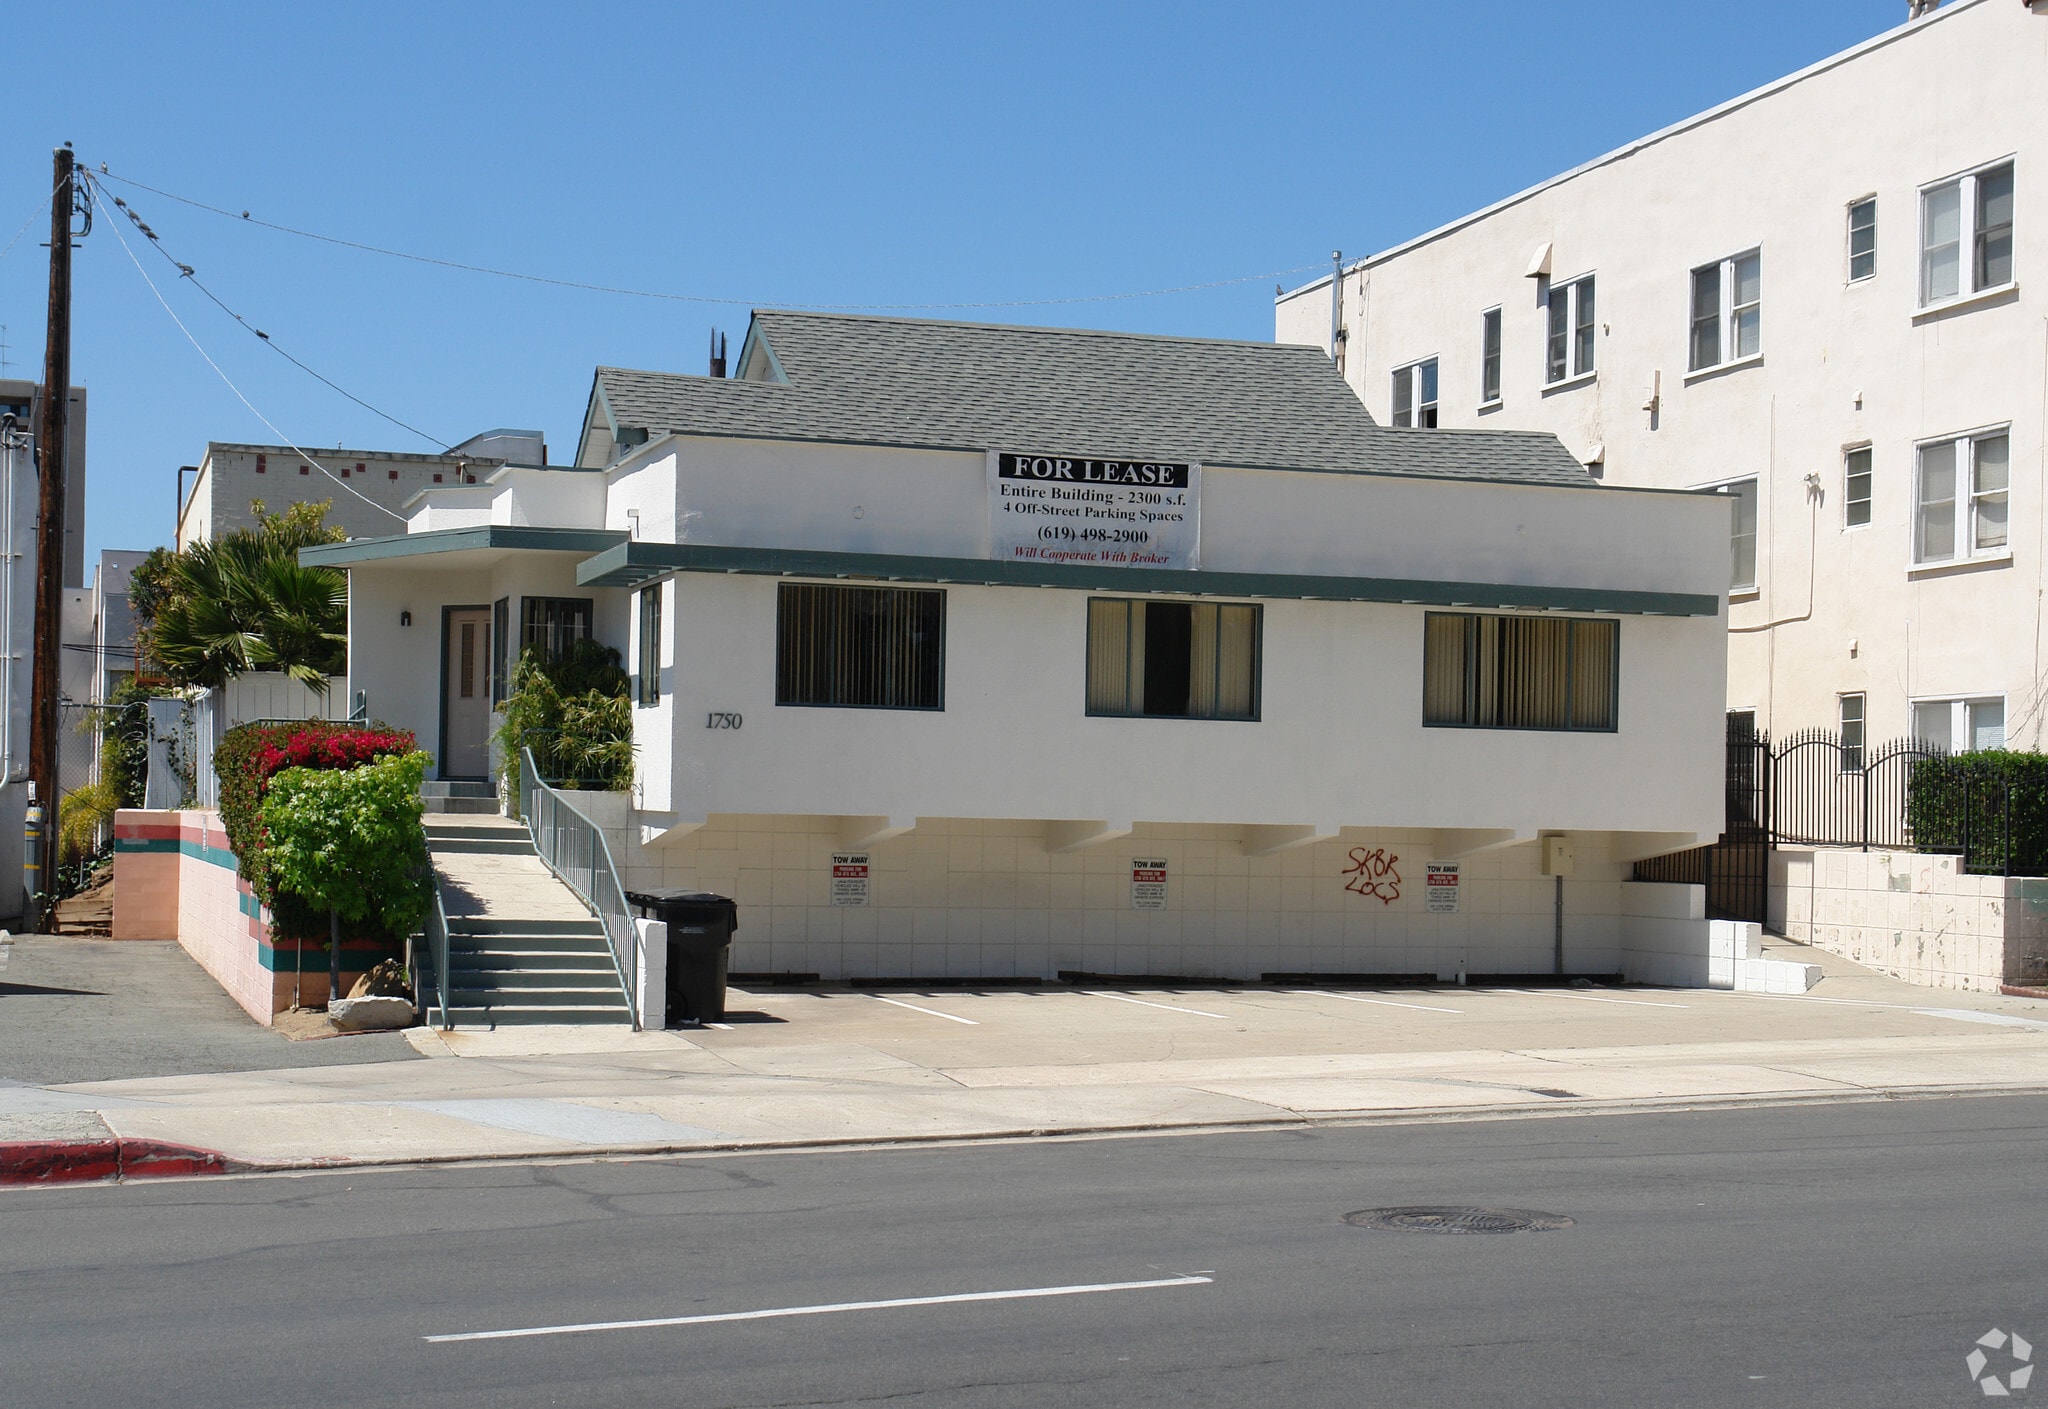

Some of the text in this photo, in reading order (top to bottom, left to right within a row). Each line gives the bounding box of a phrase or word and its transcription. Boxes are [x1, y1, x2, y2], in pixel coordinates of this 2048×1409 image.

[1013, 456, 1175, 485] FOR LEASE
[1000, 483, 1046, 499] Entire
[1051, 486, 1114, 505] Building
[1128, 491, 1162, 505] 2300
[1166, 493, 1186, 506] s.f.
[1003, 502, 1184, 523] 4 Off-Street Parking Spaces
[1037, 525, 1149, 544] (619) 498-2900
[1014, 546, 1170, 565] Will Cooperate With Broker
[706, 712, 743, 730] 1750
[833, 856, 868, 864] TOW AWAY
[1150, 861, 1167, 869] AWAY
[1427, 865, 1459, 873] TOW AWAY
